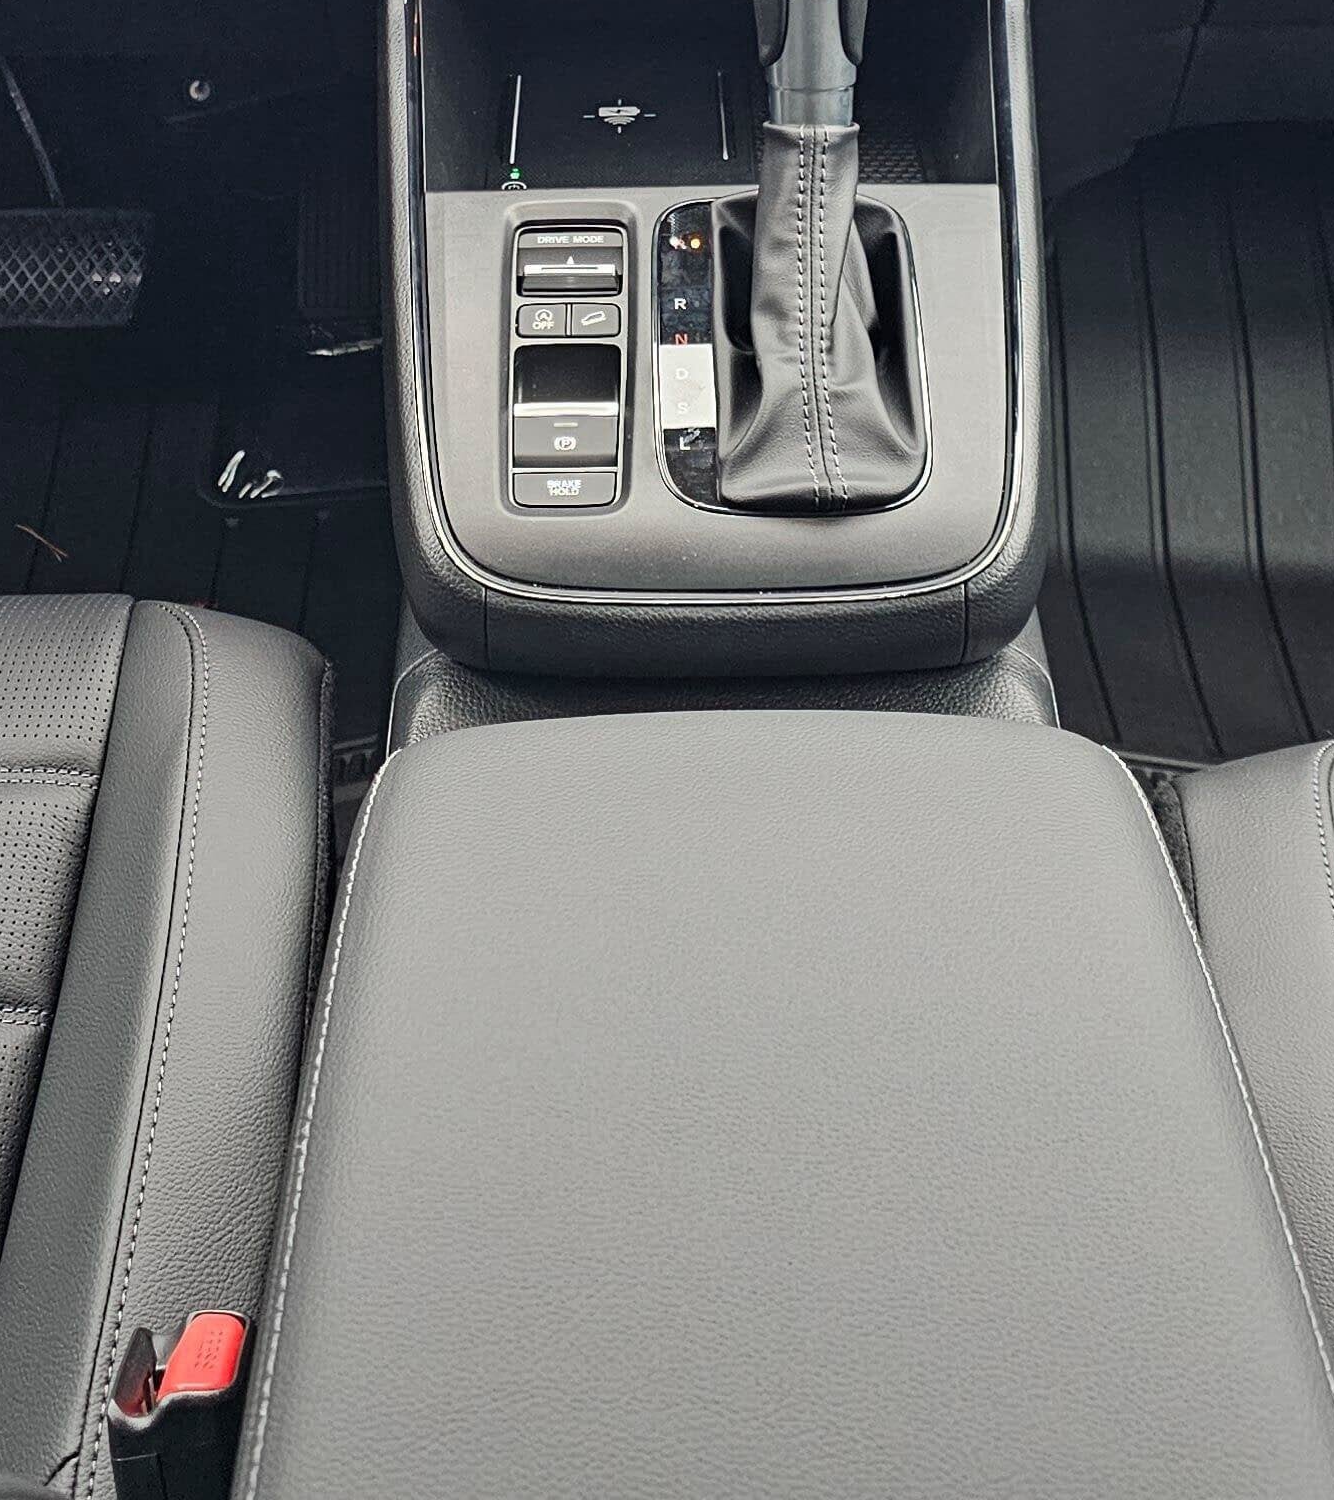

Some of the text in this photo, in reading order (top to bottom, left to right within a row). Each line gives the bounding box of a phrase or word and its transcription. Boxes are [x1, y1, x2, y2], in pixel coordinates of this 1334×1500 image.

[536, 235, 604, 245] DRIVE MODE
[674, 298, 687, 310] R
[531, 321, 555, 330] OFF
[675, 333, 688, 345] N
[675, 367, 689, 380] D
[676, 402, 688, 414] S
[546, 479, 582, 488] BRAKE
[548, 487, 580, 497] HOLD
